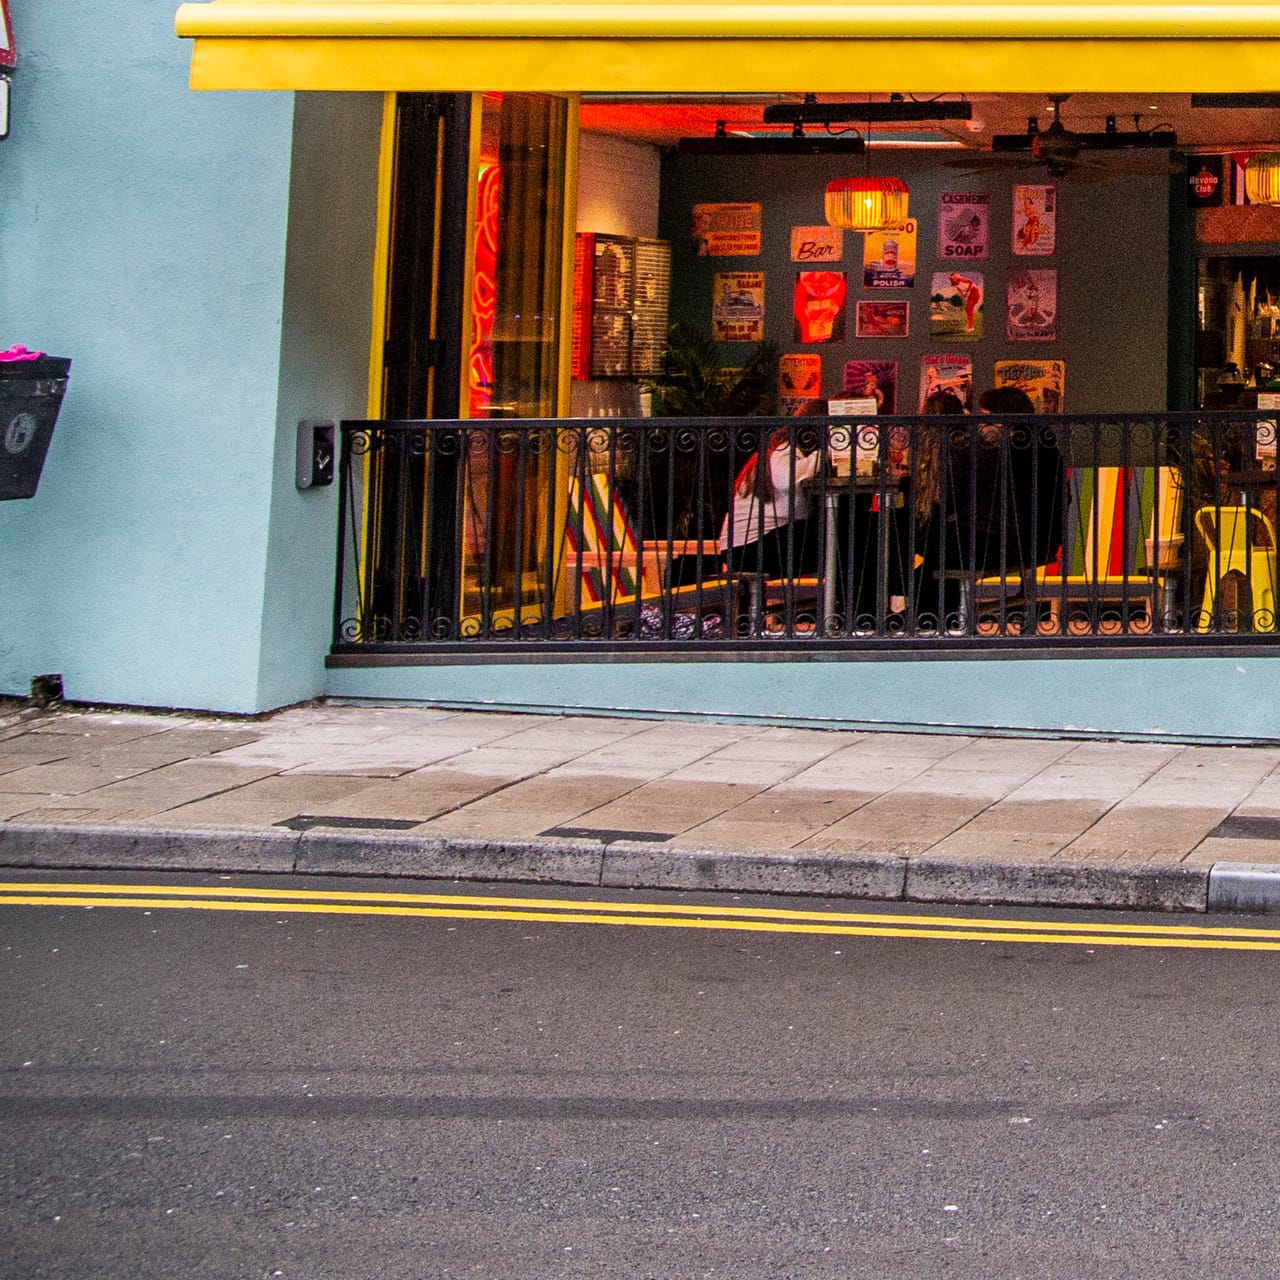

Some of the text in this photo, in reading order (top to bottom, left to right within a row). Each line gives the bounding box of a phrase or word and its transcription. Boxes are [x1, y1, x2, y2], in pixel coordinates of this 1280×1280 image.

[1189, 175, 1218, 185] Havana
[1195, 184, 1212, 193] Club
[797, 241, 834, 260] Bar
[945, 245, 983, 257] SOAP
